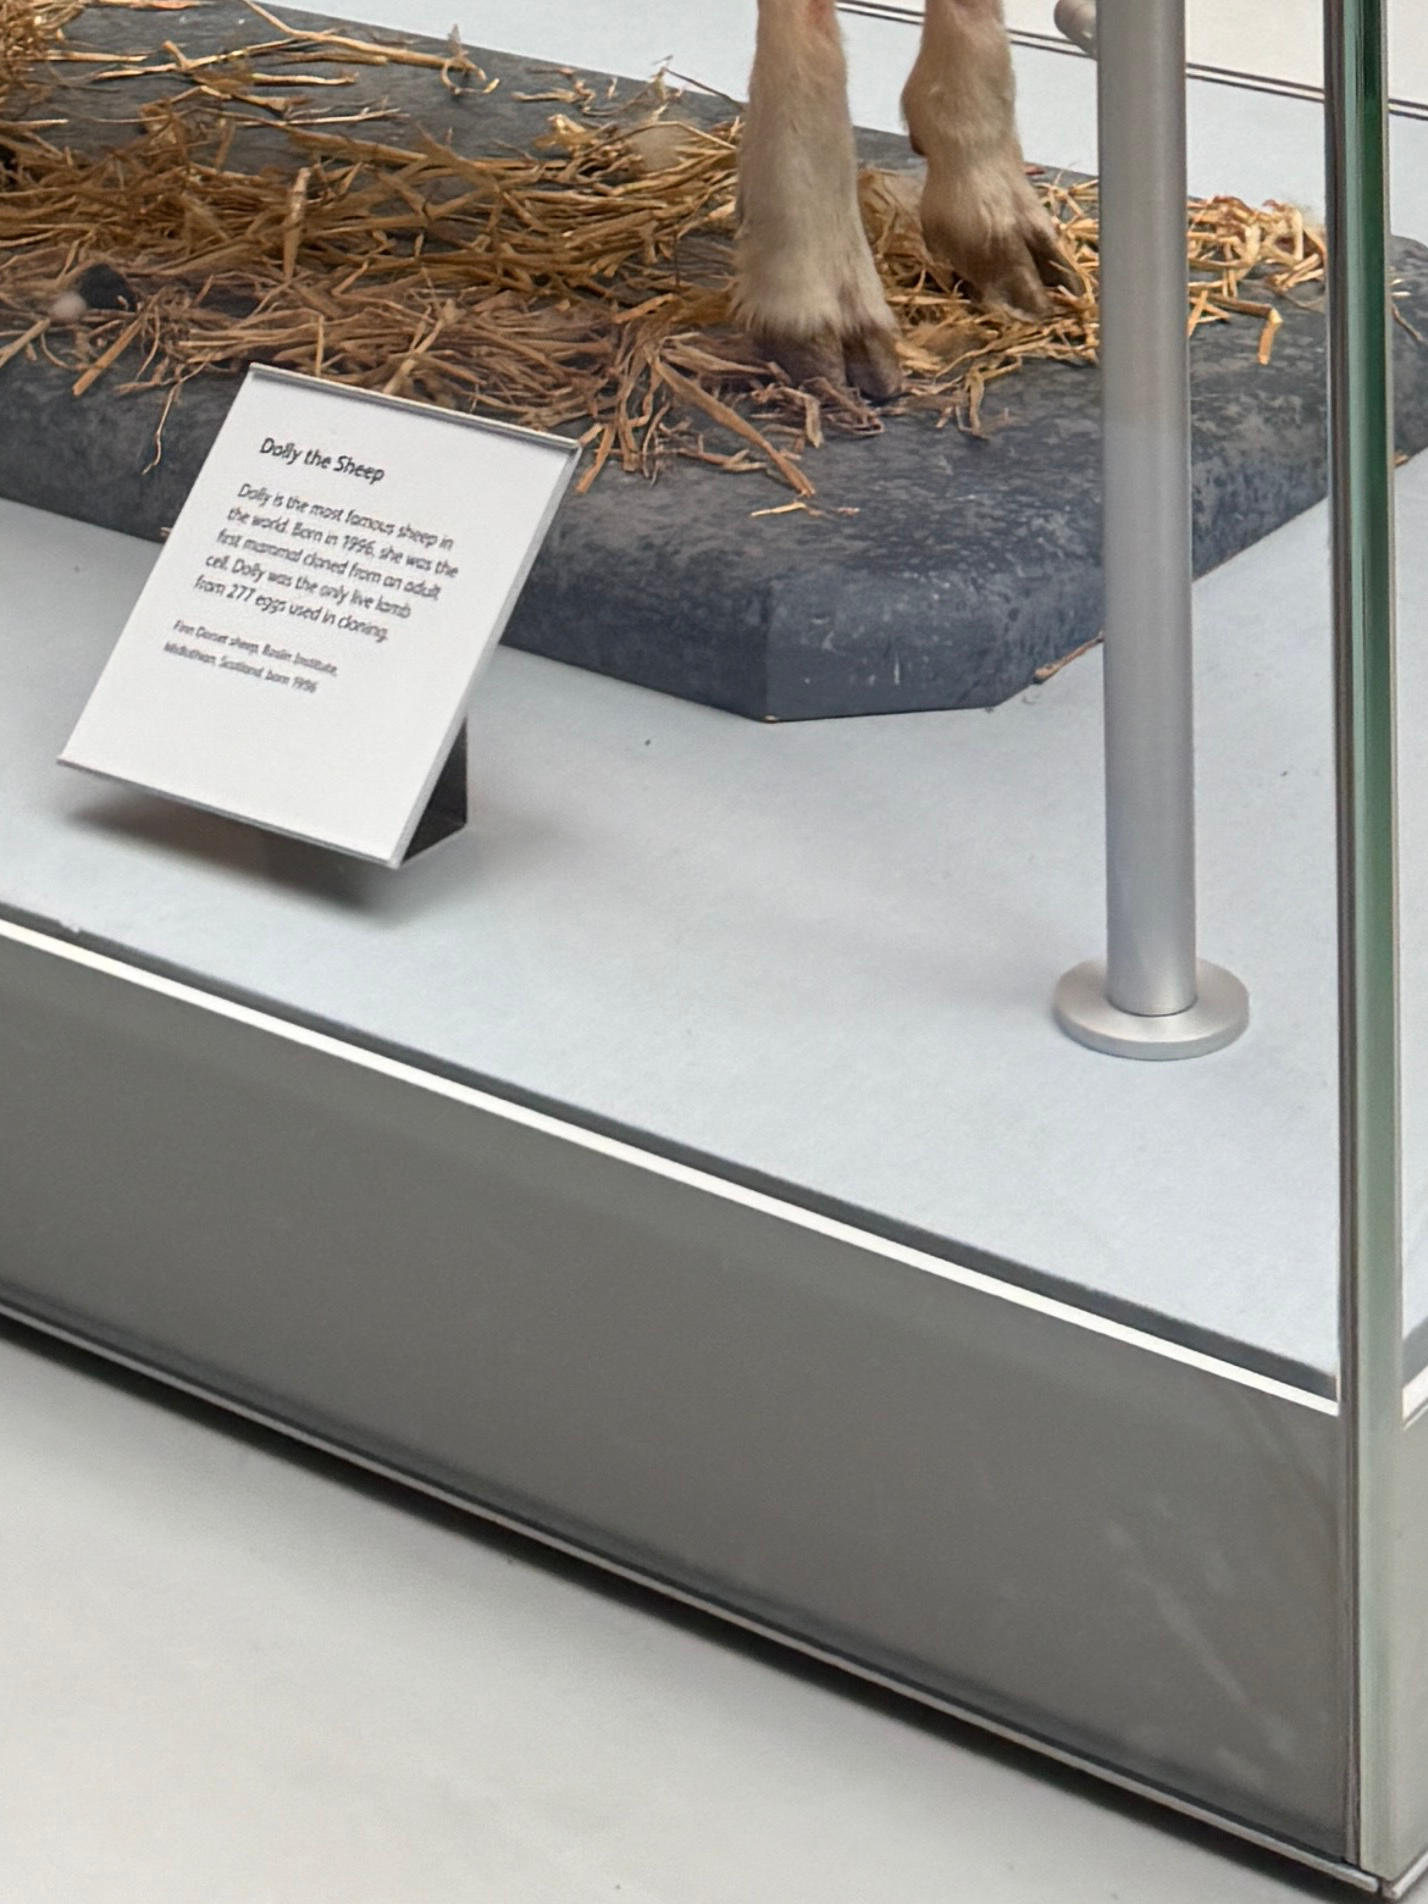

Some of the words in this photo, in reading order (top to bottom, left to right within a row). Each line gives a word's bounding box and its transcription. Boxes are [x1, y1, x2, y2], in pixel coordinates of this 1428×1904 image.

[260, 437, 302, 465] Dolly
[304, 449, 331, 469] the
[334, 455, 385, 484] Sheep
[227, 506, 250, 524] the
[292, 521, 323, 542] Born
[324, 531, 338, 546] in
[378, 546, 404, 564] she
[405, 555, 432, 571] was
[434, 560, 458, 578] the
[238, 483, 272, 507] Dolly
[272, 493, 285, 507] is
[286, 496, 309, 513] the
[310, 504, 344, 522] most
[344, 509, 395, 535] famous
[396, 523, 438, 548] sheep
[439, 534, 454, 551] in
[205, 555, 231, 571] cell.
[232, 558, 266, 583] Dolly
[268, 571, 293, 587] was
[295, 576, 318, 593] the
[319, 584, 350, 606] only
[350, 588, 374, 609] live
[375, 595, 411, 619] lamb
[217, 528, 242, 548] first
[243, 538, 304, 562] mammal
[303, 552, 349, 574] cloned
[348, 562, 382, 583] from
[383, 576, 402, 590] an
[404, 580, 441, 601] adult
[194, 574, 226, 596] from
[227, 583, 256, 602] 277
[255, 595, 287, 615] eggs
[289, 604, 323, 621] used
[322, 609, 336, 625] in
